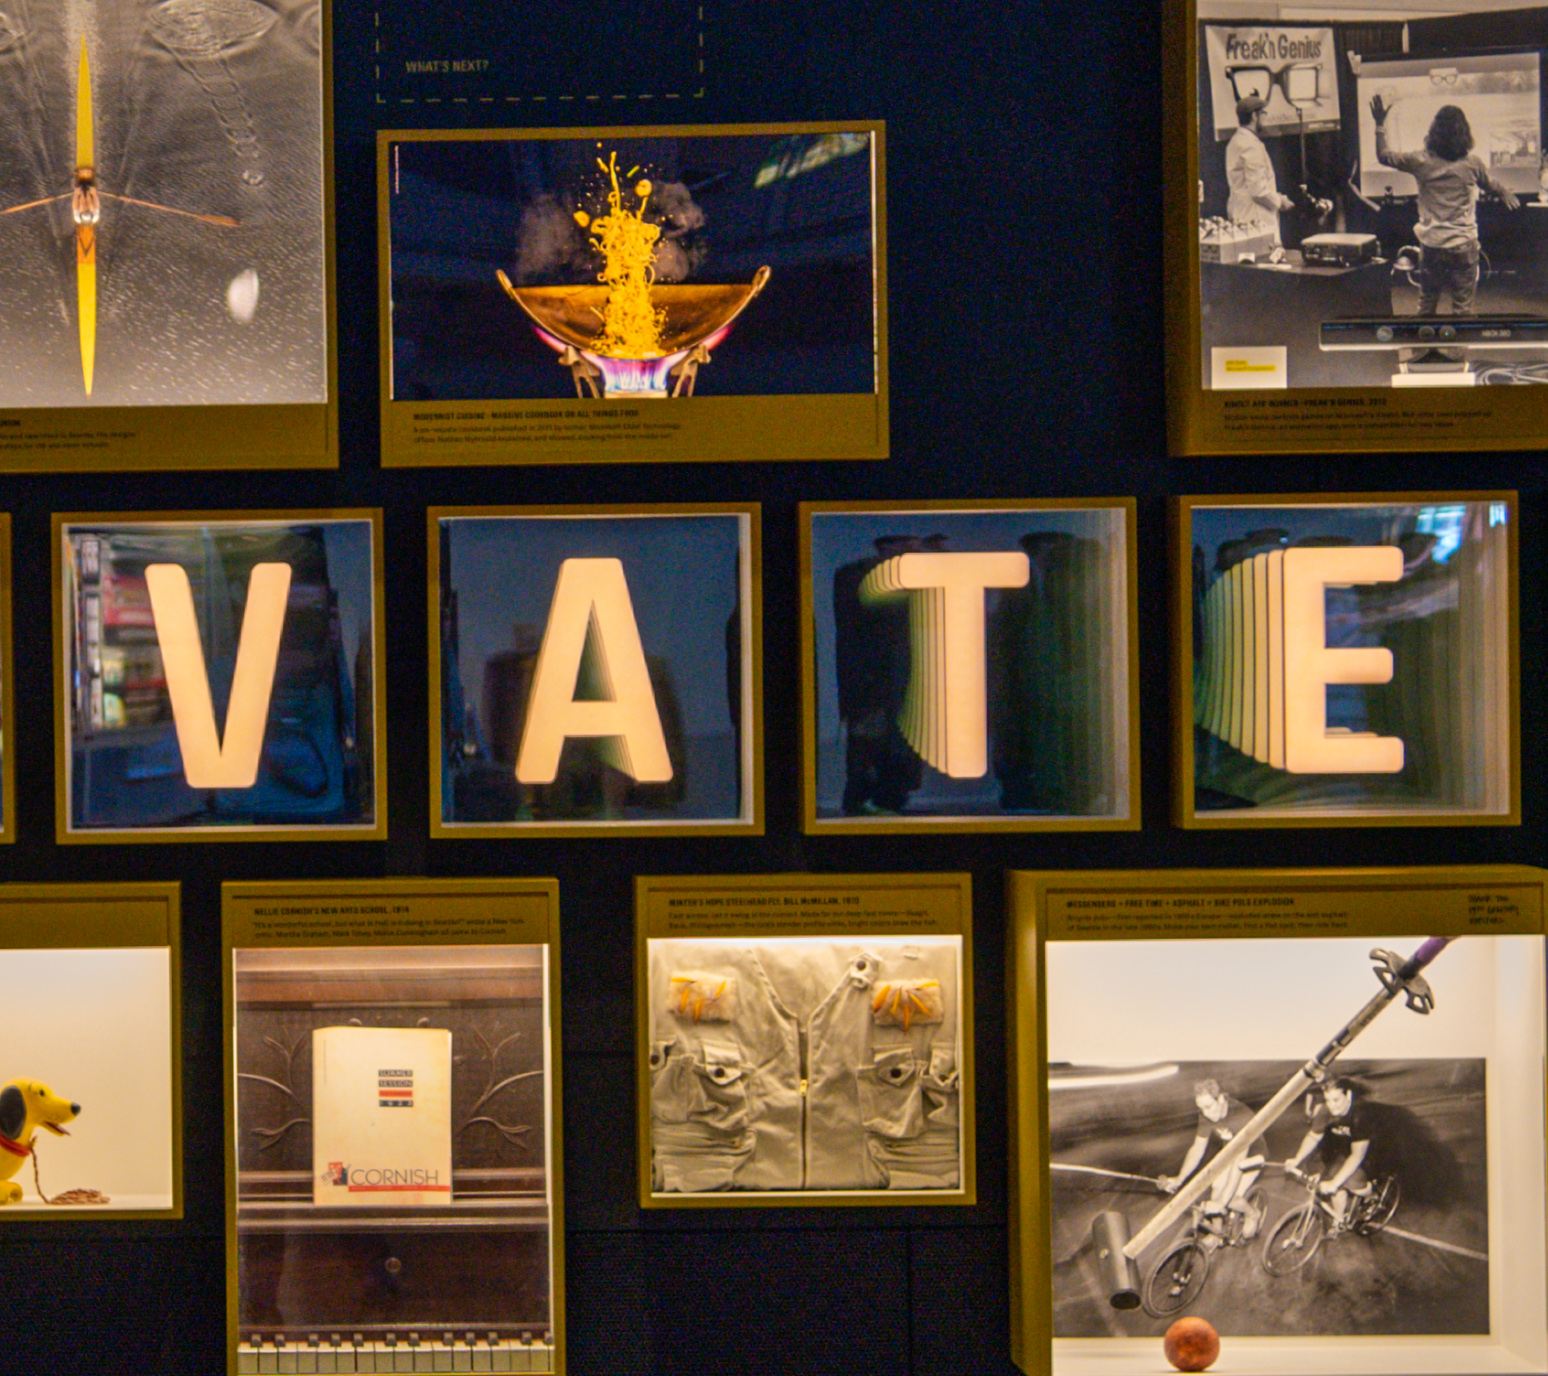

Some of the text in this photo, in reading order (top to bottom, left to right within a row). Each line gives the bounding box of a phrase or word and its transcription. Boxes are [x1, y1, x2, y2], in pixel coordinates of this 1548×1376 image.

[1226, 32, 1321, 60] Freak'n Genius
[405, 59, 489, 73] WHAT'S NEXT?
[726, 898, 767, 906] STEELHEAD
[1172, 900, 1205, 908] ASPHALT
[1253, 899, 1295, 907] EXPLOSION
[350, 1168, 439, 1185] CORNISH
